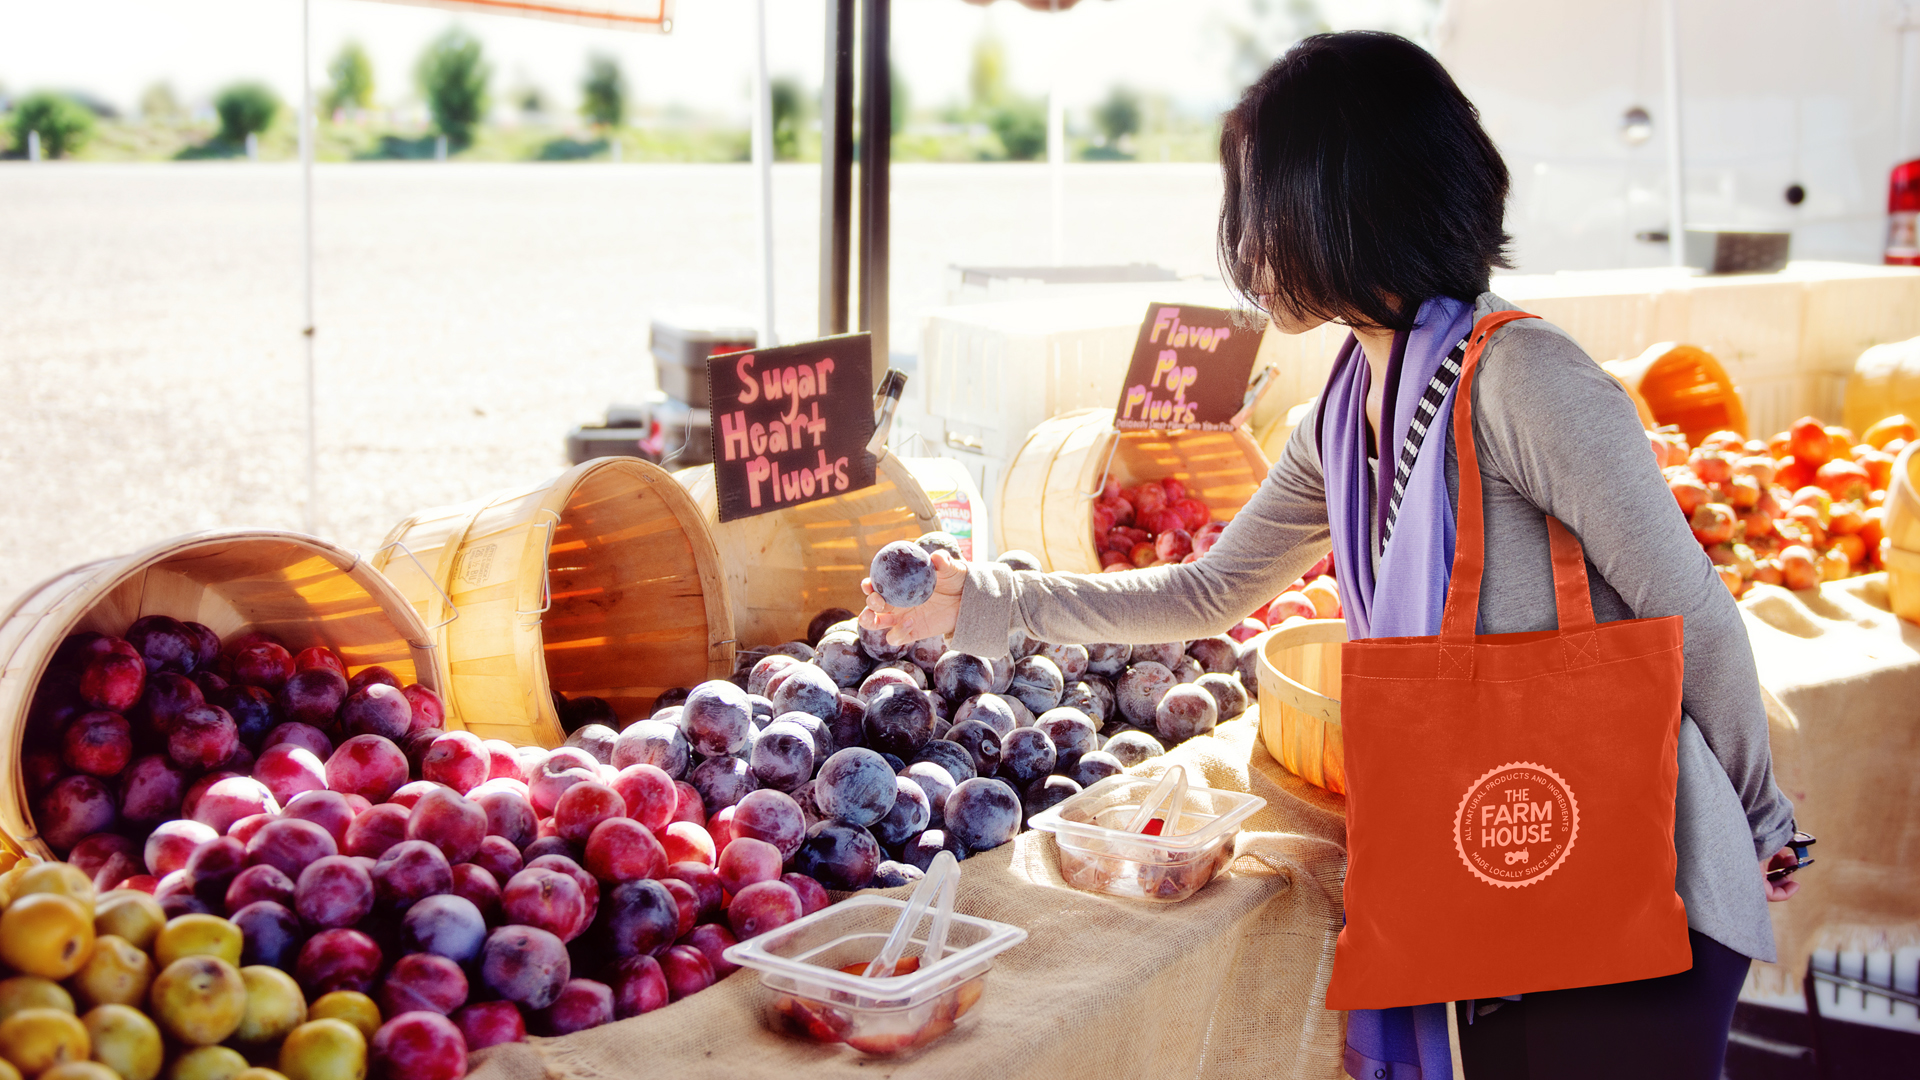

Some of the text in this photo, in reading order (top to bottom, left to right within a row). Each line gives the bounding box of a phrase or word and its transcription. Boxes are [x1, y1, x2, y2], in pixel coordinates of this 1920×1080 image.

[1150, 307, 1230, 353] Flavor
[736, 354, 835, 425] Sugar
[1151, 349, 1198, 401] Pop
[1123, 384, 1198, 424] Pluots
[720, 402, 827, 462] Heart
[745, 449, 849, 509] Pluots
[1466, 791, 1487, 825] NATURAL
[1485, 772, 1530, 791] PRODUCTS
[1531, 774, 1547, 786] AND
[1546, 782, 1569, 832] INGREDIENTS
[1481, 800, 1553, 826] FARM
[1504, 788, 1530, 803] THE
[1481, 823, 1552, 848] HOUSE
[1471, 843, 1562, 878] MADE LOCALLY SINCE 1926
